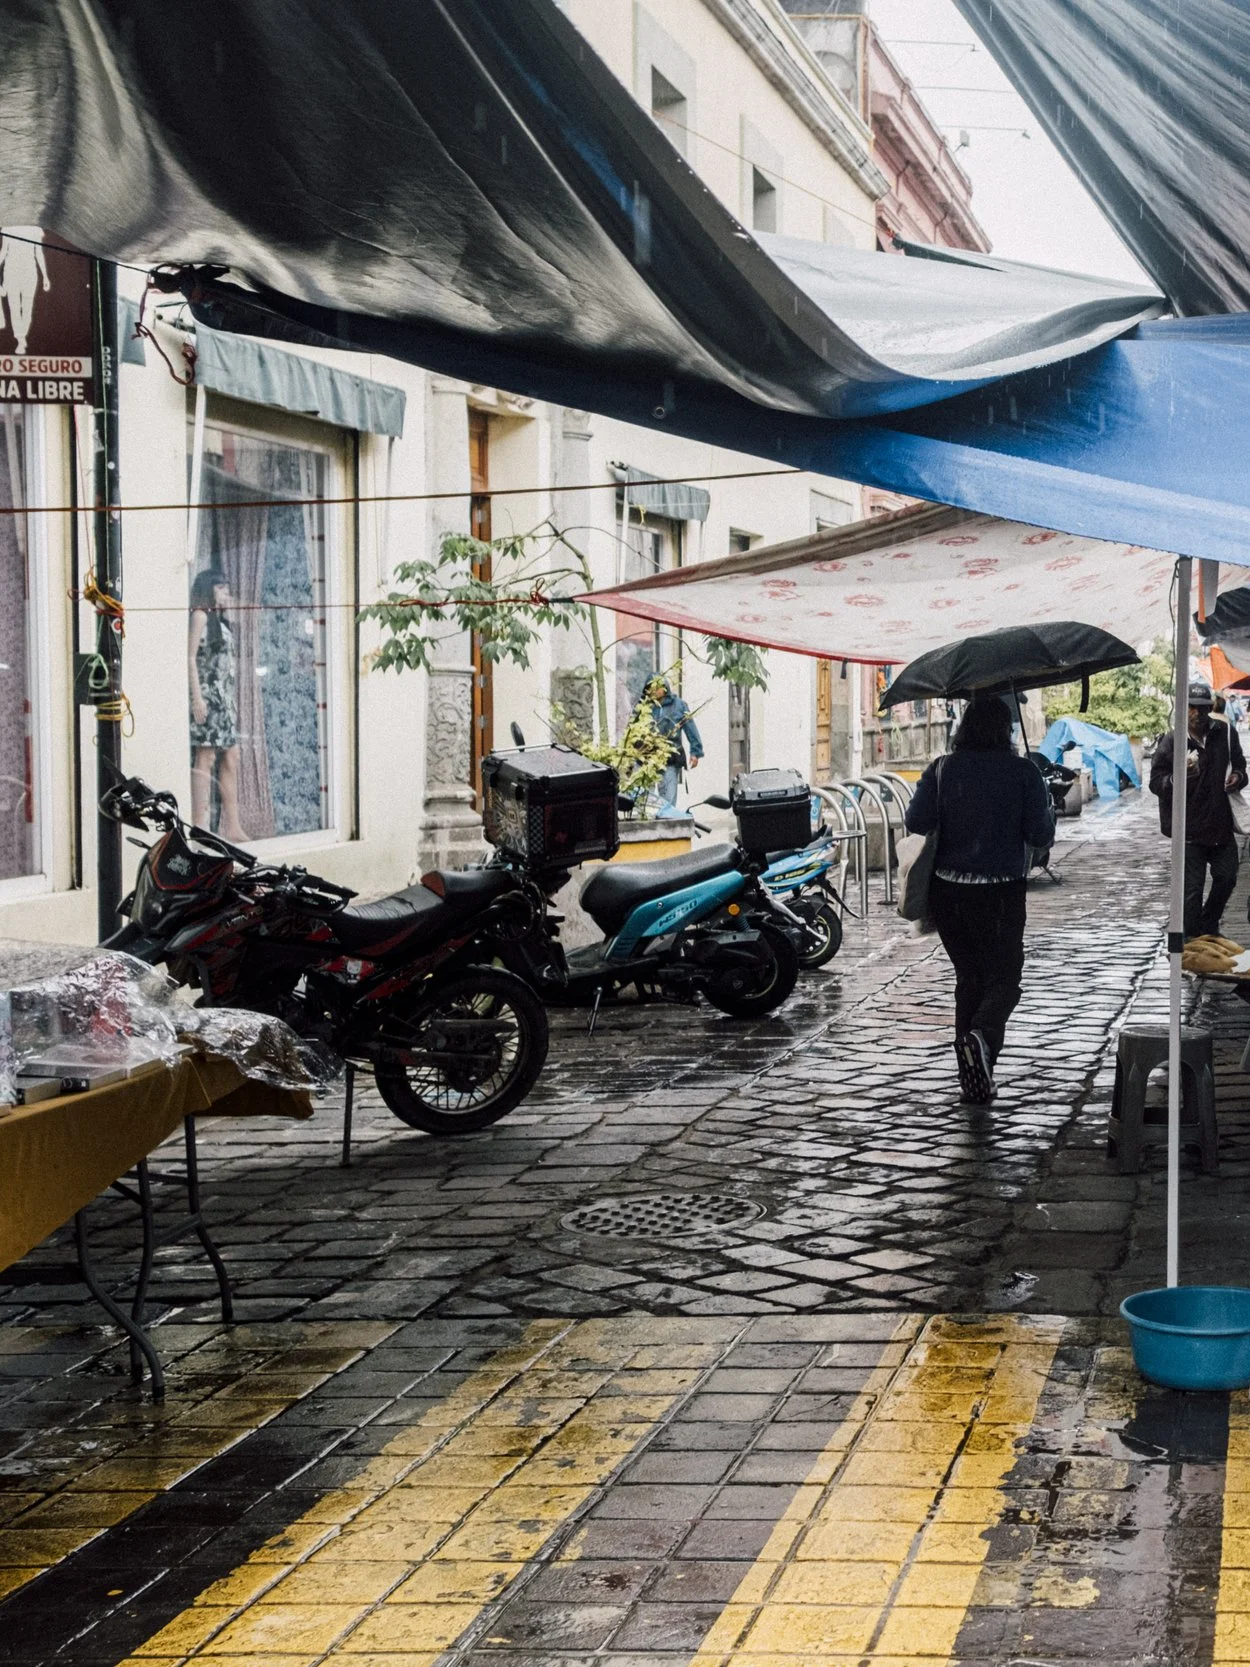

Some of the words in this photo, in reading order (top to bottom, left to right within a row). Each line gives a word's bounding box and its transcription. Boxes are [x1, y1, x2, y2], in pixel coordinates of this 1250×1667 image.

[0, 359, 14, 373] O
[18, 359, 83, 374] SEGURO
[26, 380, 85, 400] LIBRE
